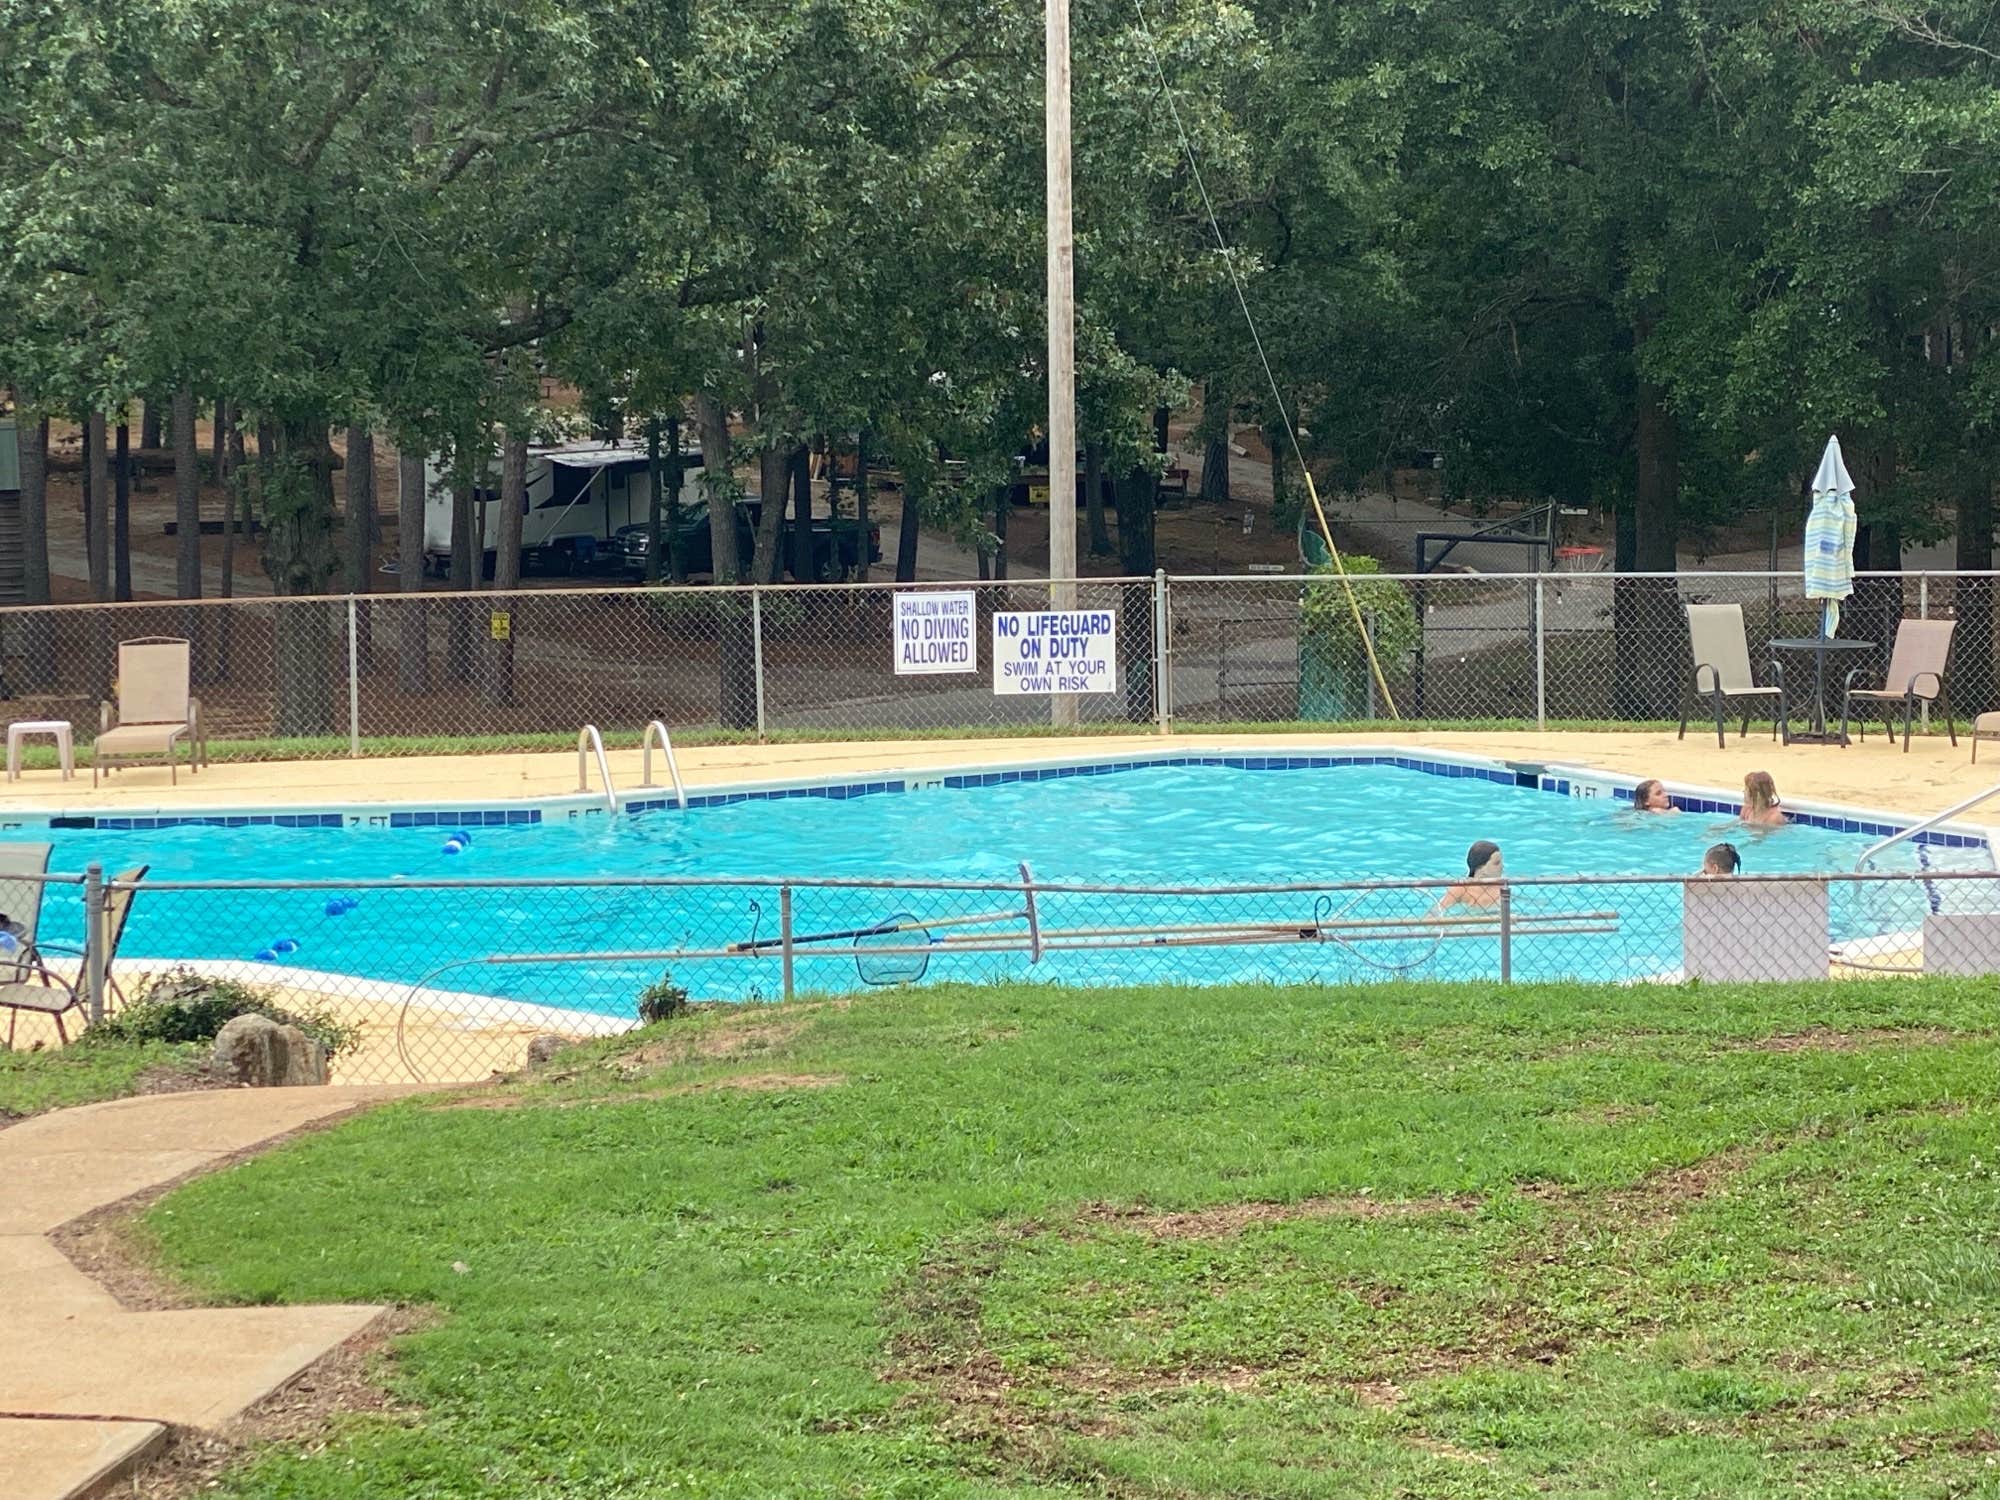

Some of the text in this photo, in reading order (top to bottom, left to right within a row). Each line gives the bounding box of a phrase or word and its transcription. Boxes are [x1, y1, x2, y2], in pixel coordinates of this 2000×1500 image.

[901, 600, 968, 616] SHALLOW WATER
[901, 617, 969, 640] NO DIVING
[998, 614, 1111, 637] NO LIFEGUARD
[903, 641, 968, 664] ALLOWED
[1020, 637, 1088, 659] ON DUTY
[1004, 660, 1106, 676] SWIM AT YOUR
[1020, 676, 1089, 691] OWN RISK
[1574, 784, 1597, 799] 3 FT
